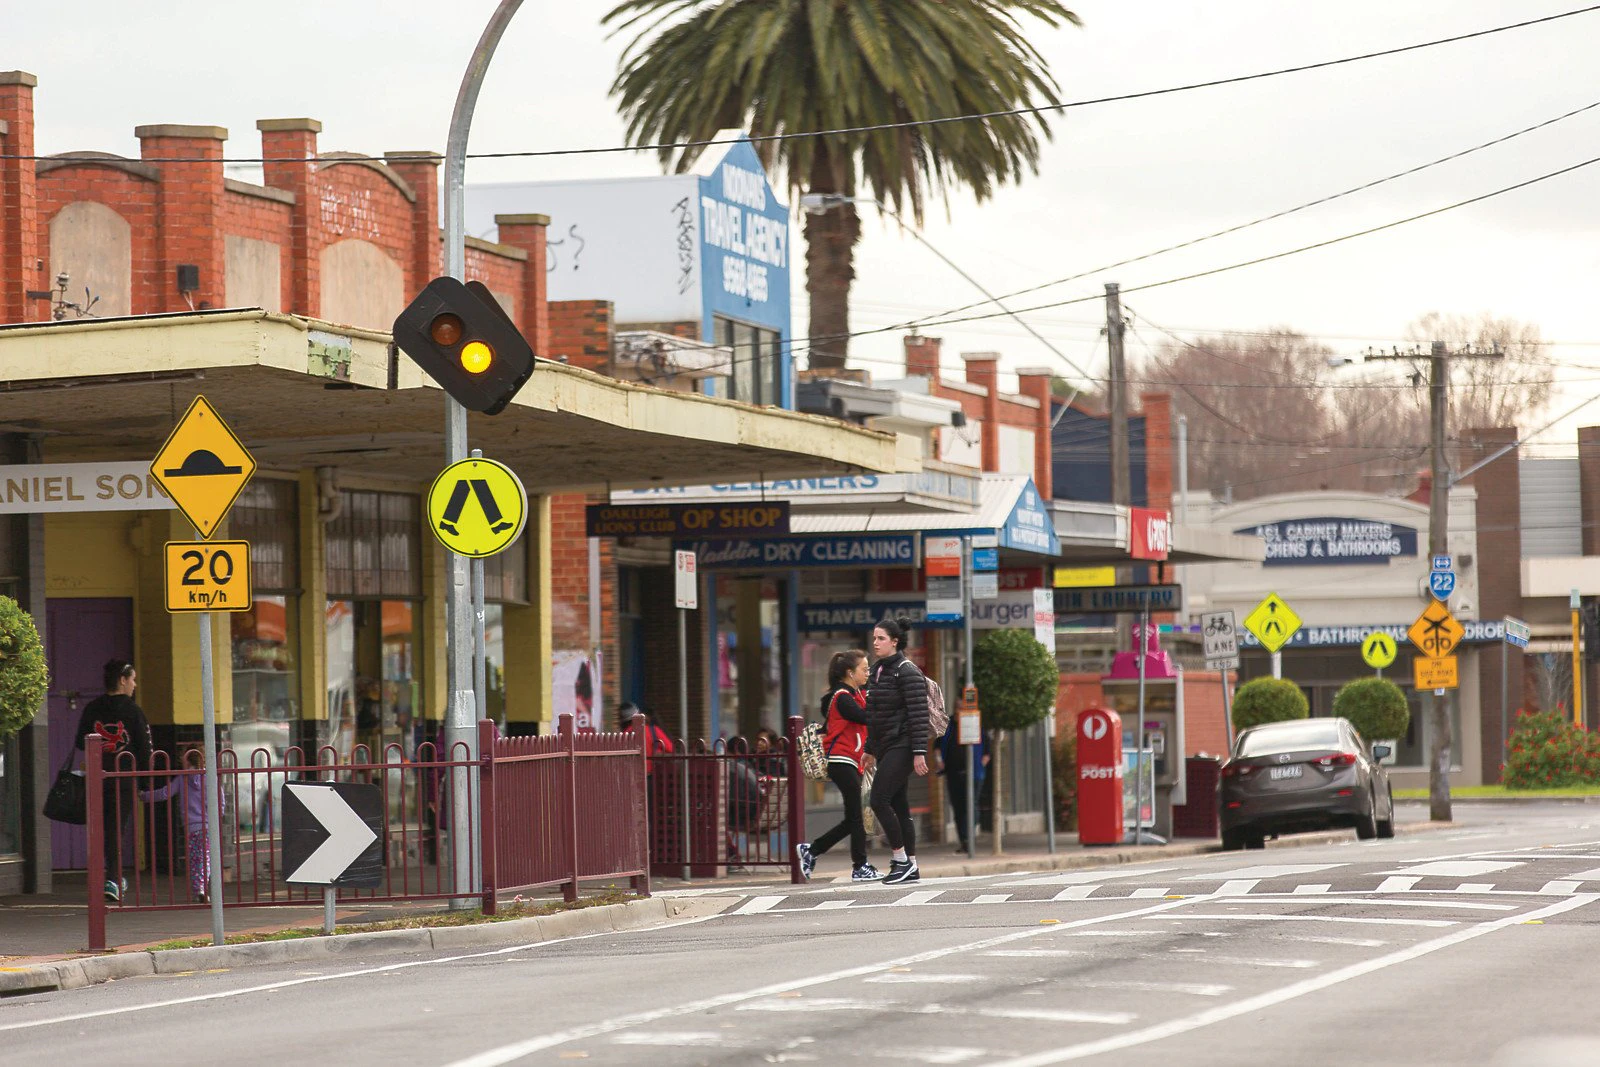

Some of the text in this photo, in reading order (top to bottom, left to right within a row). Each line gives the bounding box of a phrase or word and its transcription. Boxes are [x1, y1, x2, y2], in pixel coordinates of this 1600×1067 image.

[702, 195, 746, 256] TRAVEL
[745, 211, 787, 269] AGENCY
[0, 477, 84, 503] NIEL
[639, 520, 677, 533] CLUB
[682, 507, 782, 529] OP SHOP
[1286, 523, 1338, 541] CABINET
[1341, 522, 1393, 540] MAKERS
[692, 540, 760, 564] laddin
[764, 543, 806, 561] DRY
[812, 540, 912, 560] CLEANING
[1265, 537, 1402, 558] CHENS & BATHROOMS
[182, 550, 233, 586] 20
[1433, 574, 1453, 591] 22
[189, 590, 227, 606] km/h
[804, 608, 877, 625] TRAVEL
[1308, 626, 1408, 645] BATHROMS
[1207, 641, 1235, 655] LANE
[1213, 660, 1232, 670] END
[1081, 766, 1114, 779] POST
